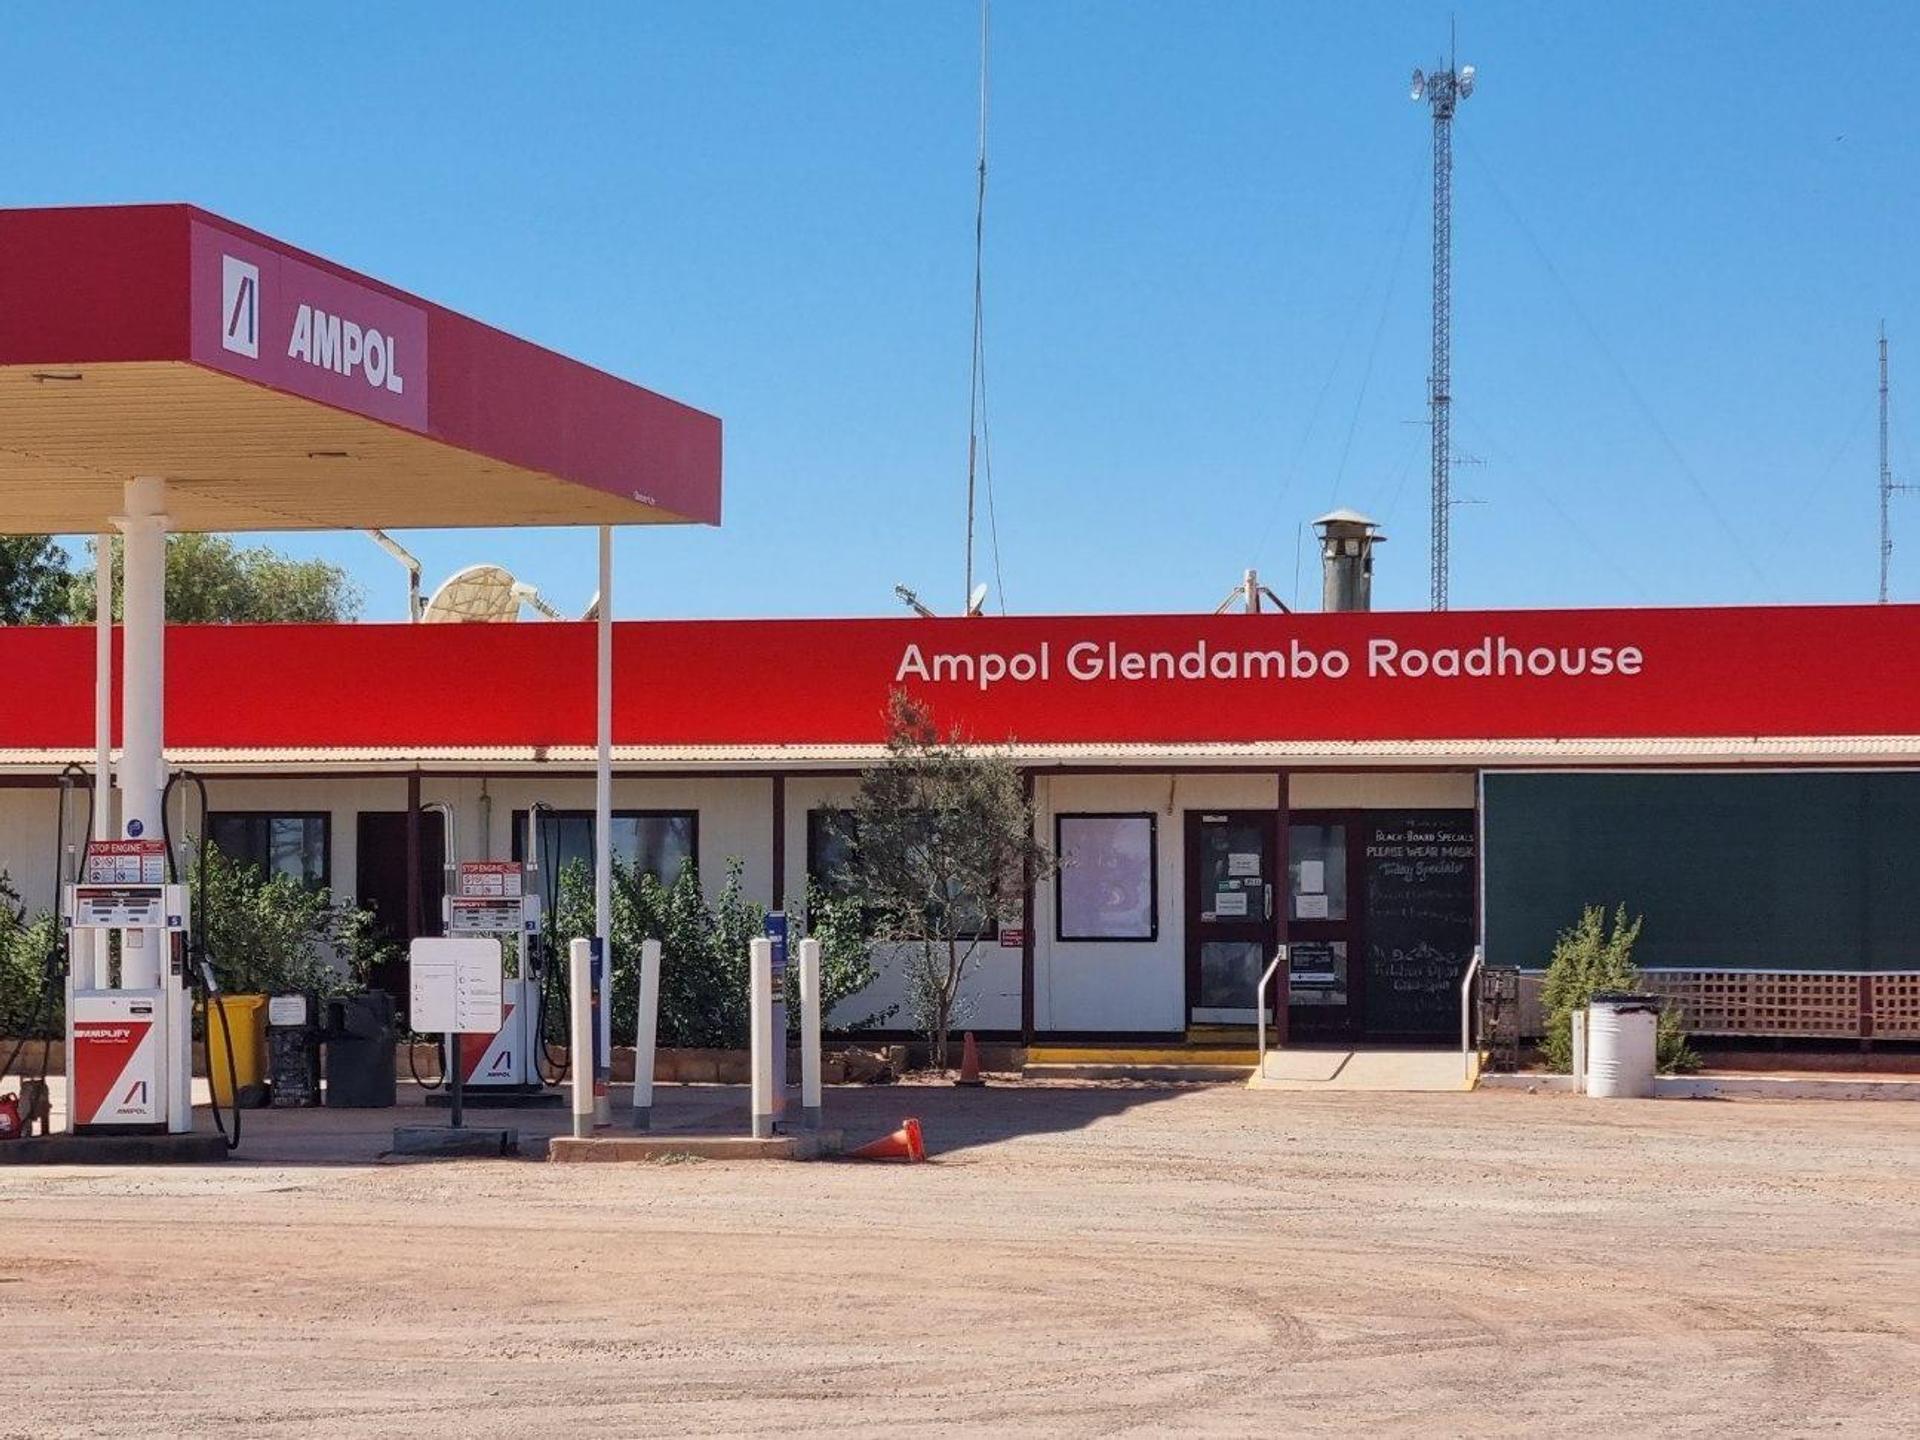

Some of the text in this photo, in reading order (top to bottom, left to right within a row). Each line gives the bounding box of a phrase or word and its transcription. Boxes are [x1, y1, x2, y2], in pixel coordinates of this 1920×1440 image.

[288, 304, 403, 395] AMPOL
[896, 637, 1644, 690] Ampol Glendambo Roadhouse
[90, 843, 109, 853] STOP
[111, 843, 141, 853] ENGINE
